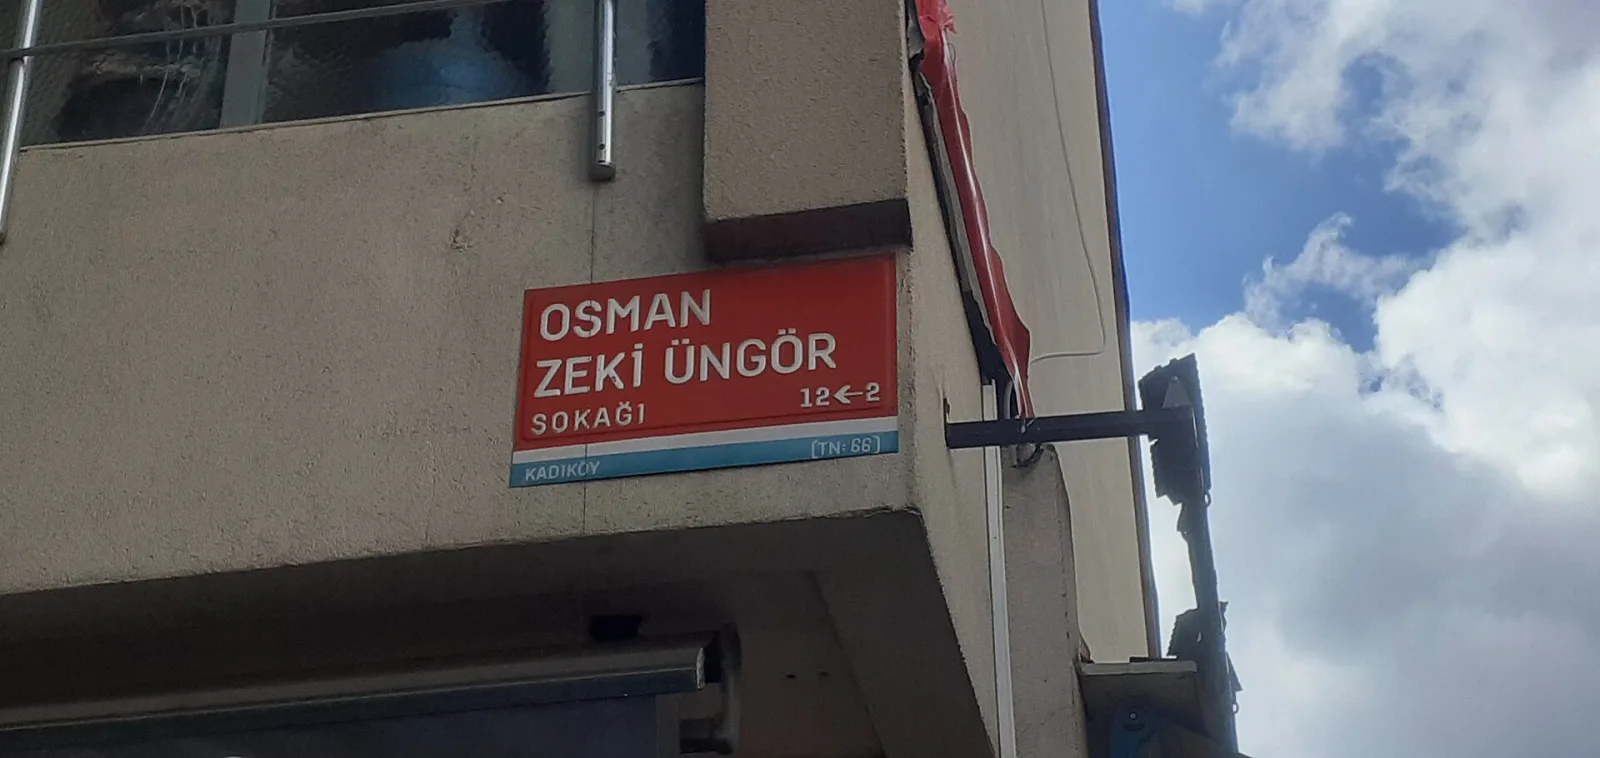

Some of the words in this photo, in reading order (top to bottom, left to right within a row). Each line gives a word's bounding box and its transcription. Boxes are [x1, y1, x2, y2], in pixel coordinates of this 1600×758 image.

[540, 289, 711, 341] OSMAN
[533, 342, 644, 398] ZEKİ
[664, 327, 836, 384] ÜNGÖR
[531, 401, 645, 435] SOKAĞI
[525, 460, 600, 481] KADIKÖY
